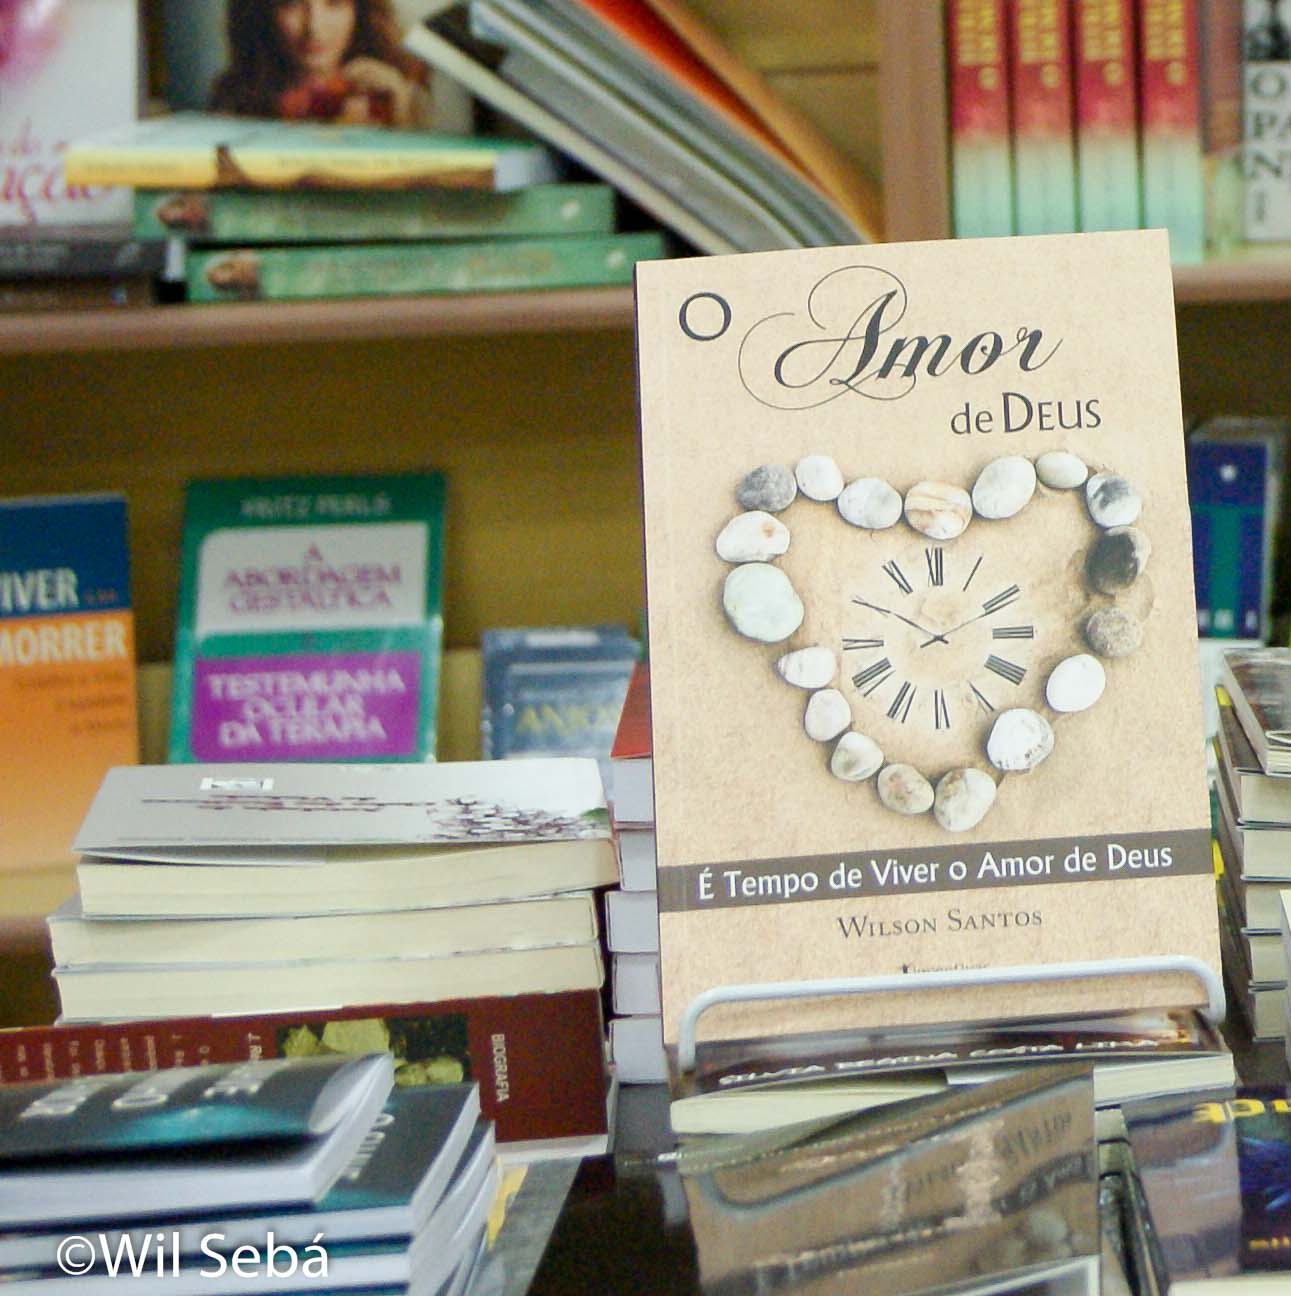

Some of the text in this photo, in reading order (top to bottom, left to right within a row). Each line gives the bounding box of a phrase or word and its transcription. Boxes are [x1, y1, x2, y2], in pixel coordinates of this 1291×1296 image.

[1250, 68, 1289, 100] O
[678, 291, 732, 342] O
[738, 264, 1064, 411] Amor
[950, 401, 994, 435] de
[0, 566, 80, 613] IVER
[698, 841, 1174, 901] É Tempo de Viver o Amor de Deus
[490, 1032, 510, 1104] BIOGRAFIA
